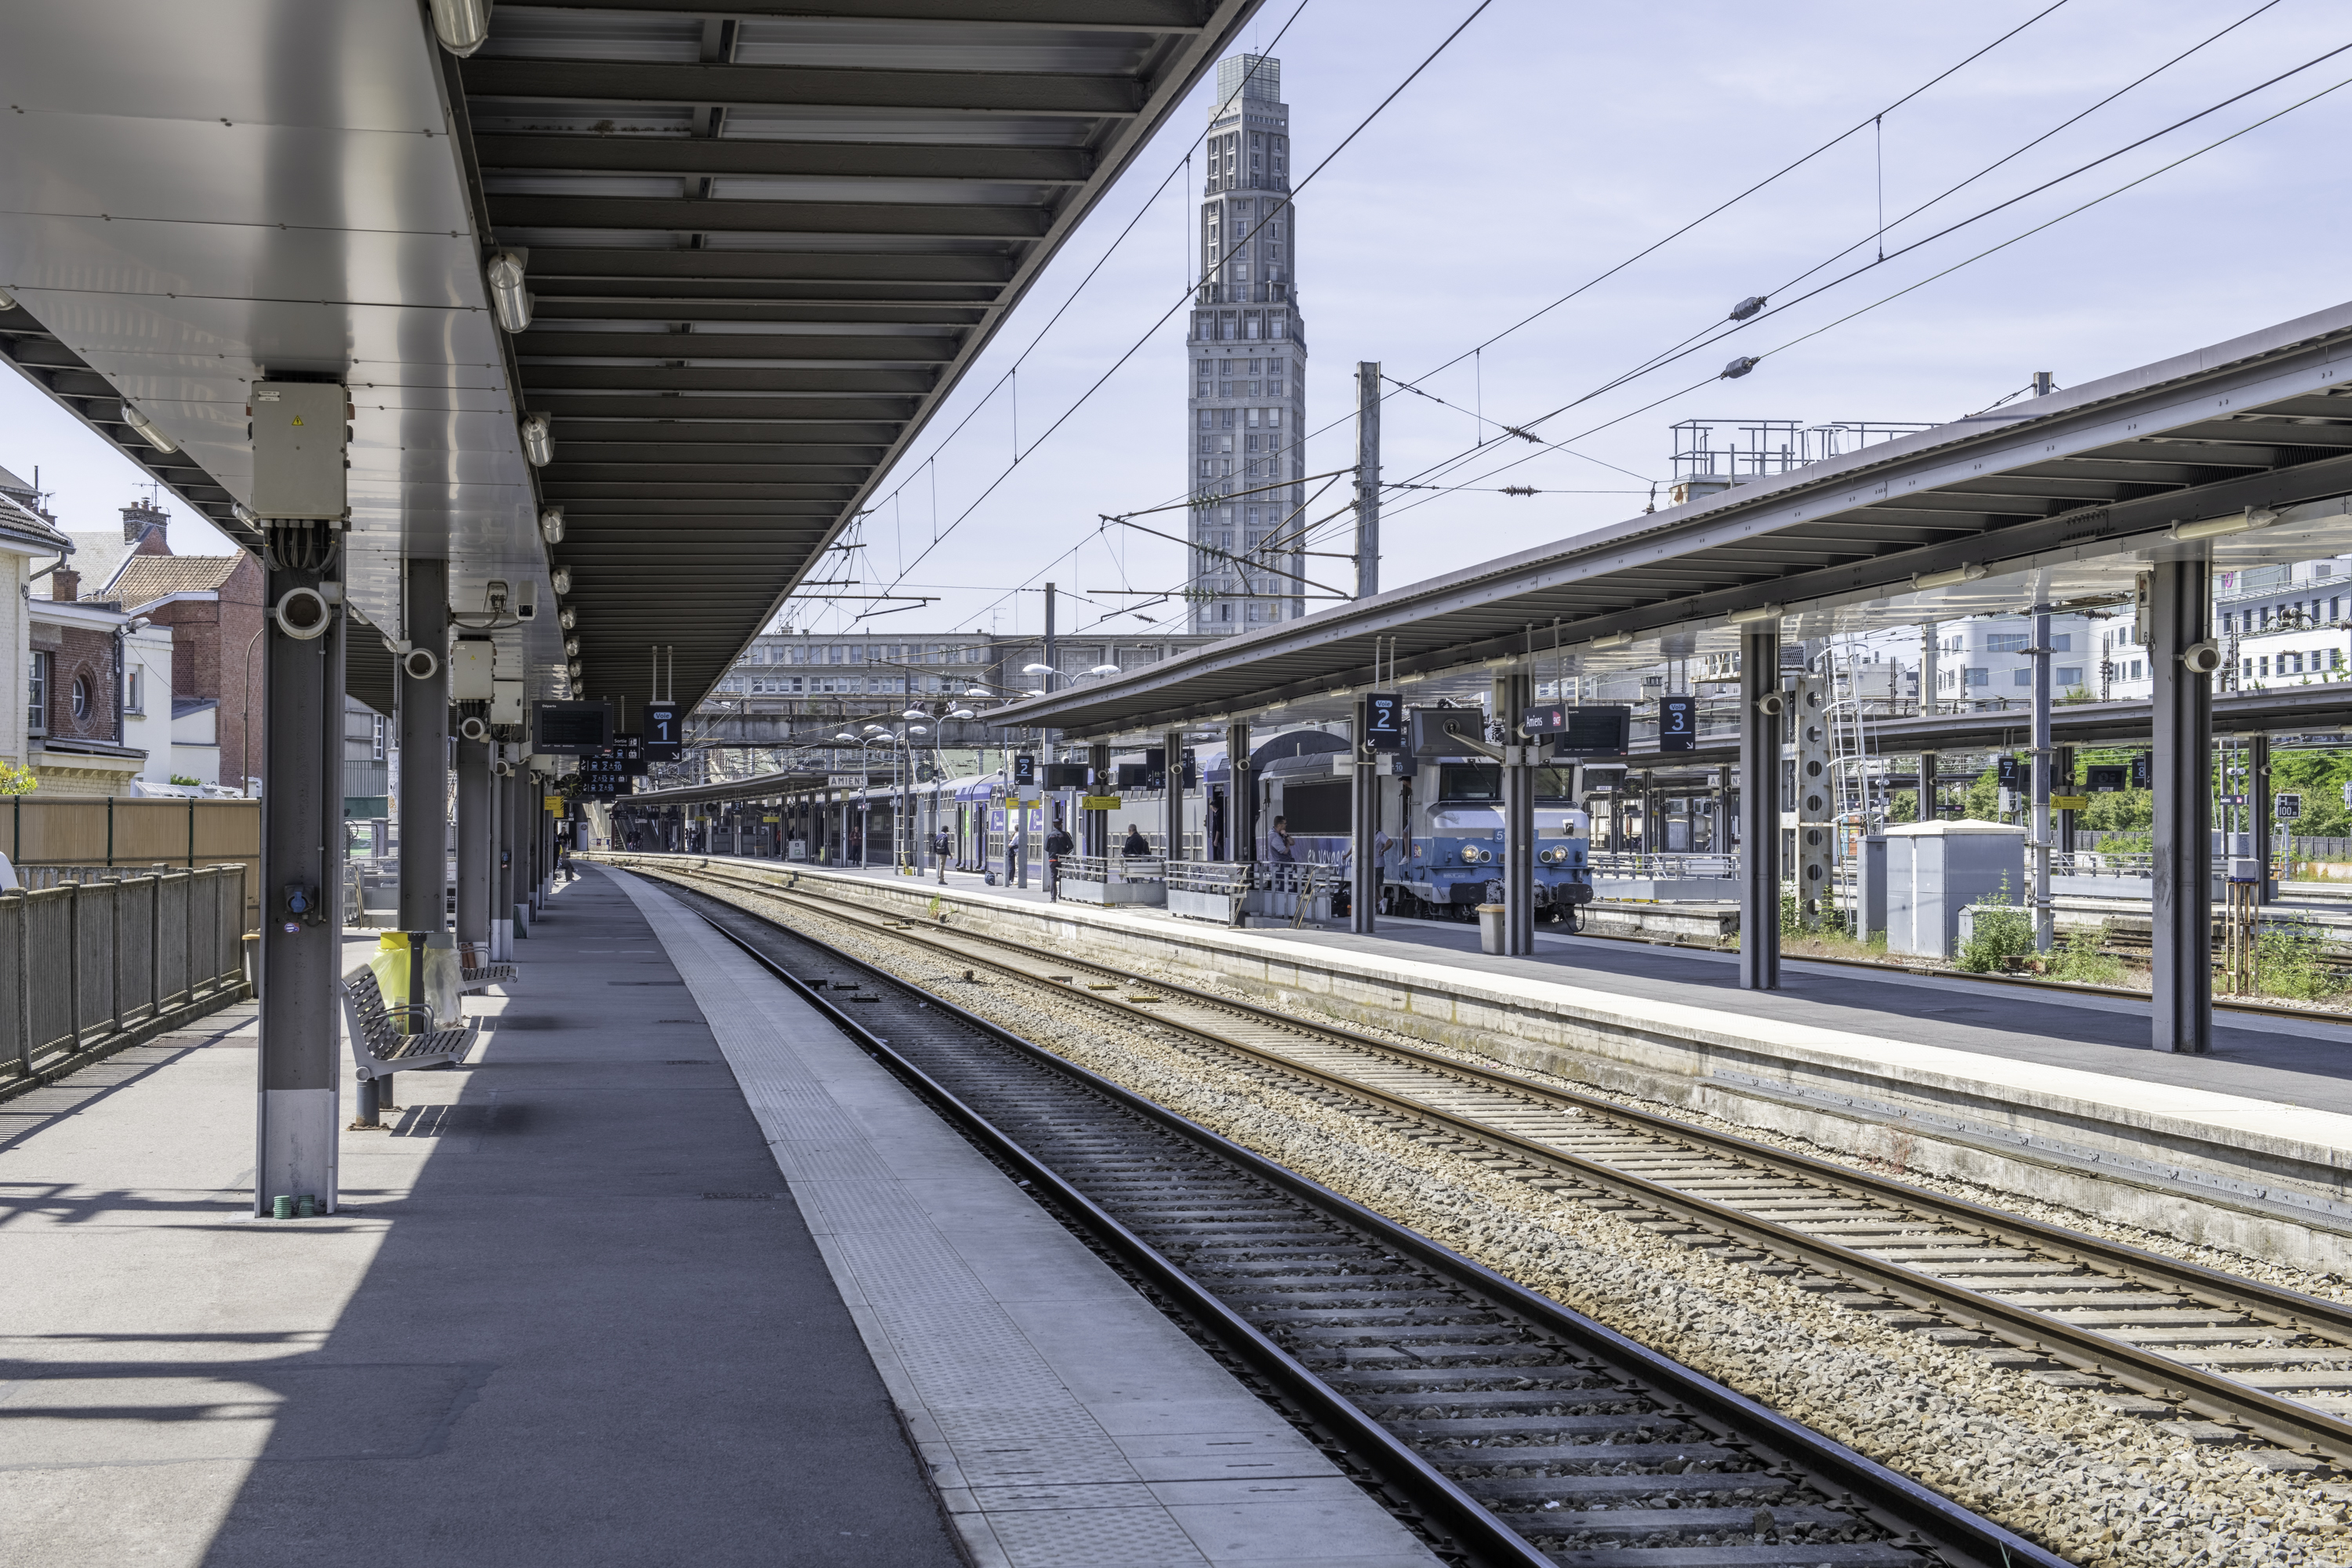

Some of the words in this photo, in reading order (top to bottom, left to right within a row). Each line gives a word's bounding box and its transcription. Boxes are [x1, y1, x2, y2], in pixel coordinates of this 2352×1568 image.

[2143, 631, 2147, 642] 6
[1377, 710, 1390, 728] 2
[1526, 715, 1543, 728] Amiens
[1671, 713, 1684, 731] 3
[657, 721, 667, 740] 1
[1021, 764, 1028, 774] 2
[2004, 767, 2012, 776] 7
[2139, 767, 2144, 776] 8
[2279, 807, 2292, 815] 100
[1308, 849, 1316, 863] en
